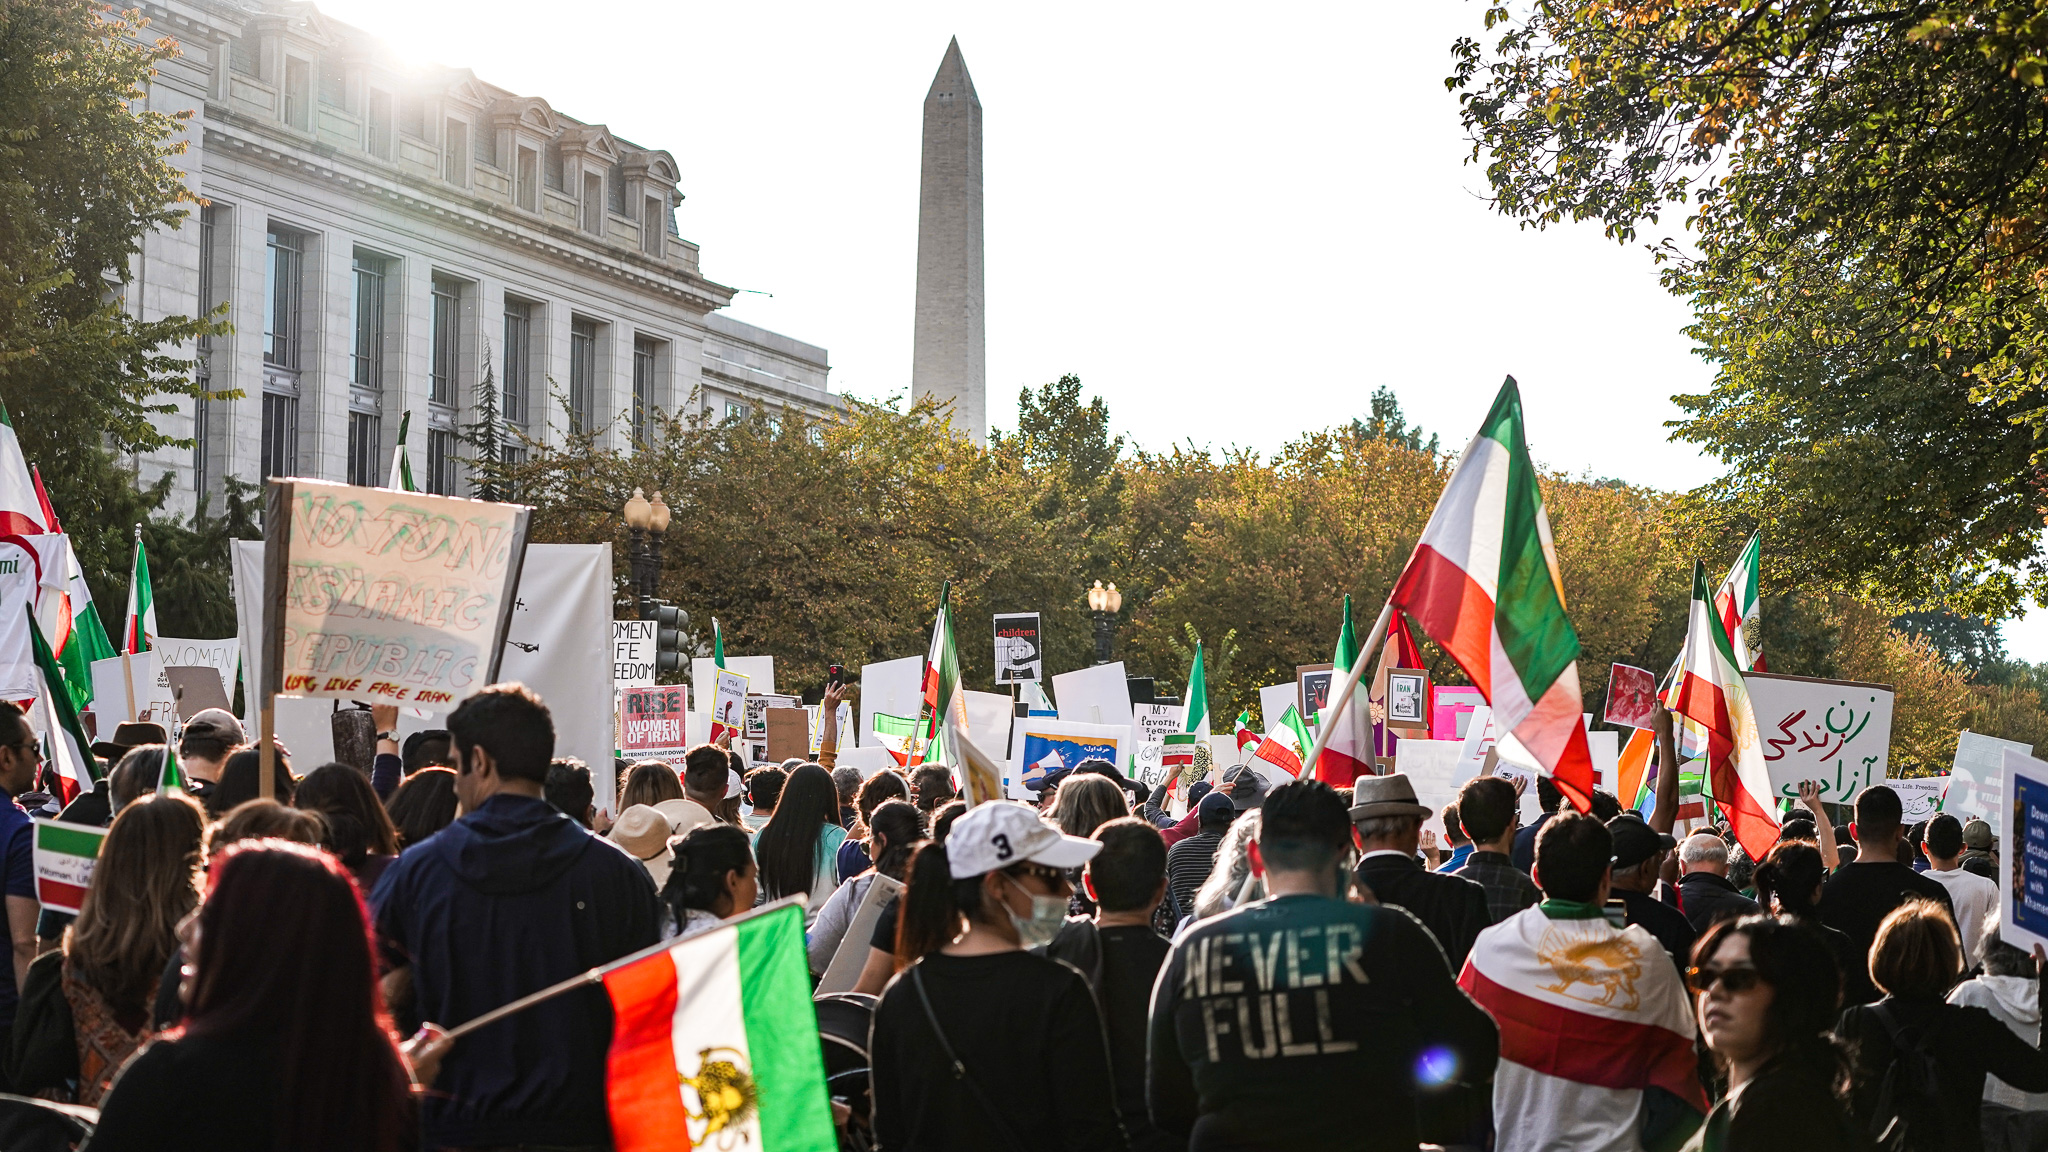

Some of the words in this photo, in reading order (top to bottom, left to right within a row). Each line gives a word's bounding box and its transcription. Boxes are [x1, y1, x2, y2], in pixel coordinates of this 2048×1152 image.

[291, 494, 358, 549] NO
[367, 508, 450, 562] TO
[0, 553, 20, 575] mi
[286, 564, 490, 632] ISLAMIC
[613, 621, 653, 640] OMEN
[998, 627, 1036, 638] children
[157, 645, 234, 669] WOMEN
[613, 662, 655, 680] EEDOM
[285, 674, 317, 692] LONG
[324, 678, 361, 692] LIVE
[368, 681, 409, 700] FREE
[415, 689, 453, 704] IRAN
[627, 691, 681, 714] RISE
[1151, 704, 1168, 715] My
[627, 719, 680, 732] WOMEN
[1825, 696, 1876, 744] زن
[627, 731, 645, 744] OF
[648, 730, 680, 743] IRAN
[1763, 709, 1846, 762] زندگی
[2030, 825, 2045, 841] with
[991, 833, 1014, 862] 3
[2025, 841, 2048, 860] dictato
[2029, 860, 2048, 879] Down
[2029, 879, 2045, 896] with
[1183, 922, 1370, 1000] NEVER
[1201, 988, 1359, 1064] FULL
